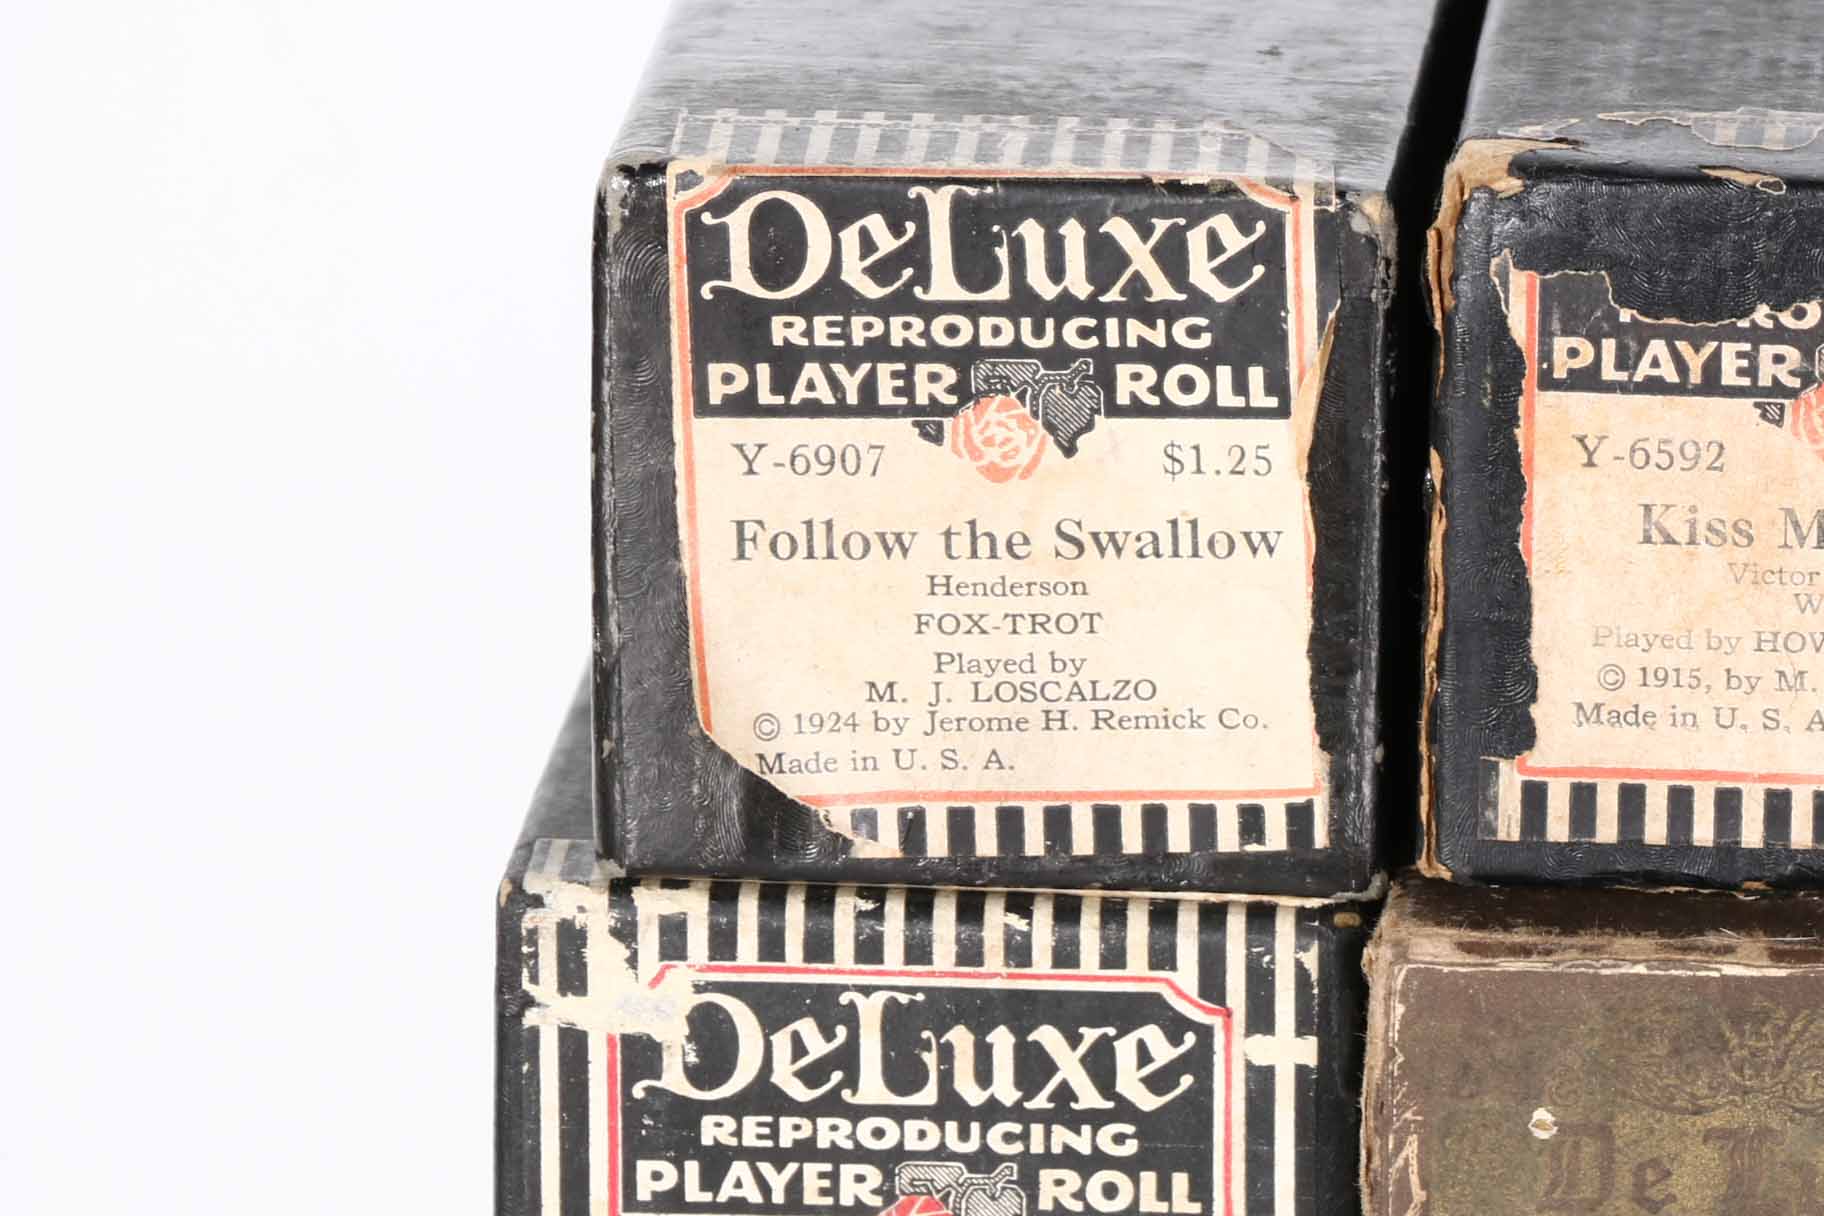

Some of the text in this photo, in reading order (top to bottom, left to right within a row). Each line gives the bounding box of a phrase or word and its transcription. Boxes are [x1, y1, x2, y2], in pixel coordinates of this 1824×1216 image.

[700, 184, 1265, 303] DeLuxe
[771, 315, 1212, 349] REPRODUCING
[1553, 336, 1801, 388] PLAYER
[708, 363, 1278, 407] PLAYER ROLL
[731, 440, 1272, 481] Y-6907 $1.25
[1571, 434, 1725, 472] Y-6592
[731, 518, 1283, 561] Follow the Swallow
[1638, 504, 1754, 548] Kiss
[926, 575, 1089, 597] Henderson
[1727, 564, 1821, 587] Victor
[914, 612, 1103, 636] FOX-TROT
[1592, 625, 1694, 654] Played
[1704, 628, 1743, 656] by
[933, 650, 1087, 678] Played by
[1639, 666, 1711, 694] 1915,
[1724, 667, 1763, 696] by
[971, 679, 1157, 703] LOSCALZO
[794, 707, 1268, 736] 1924 by Jerome Remick Co.
[1573, 702, 1699, 730] Made in
[755, 750, 880, 775] Made in
[633, 989, 1196, 1112] DeLuxe
[701, 1115, 1138, 1156] REPRODUCING
[636, 1160, 1201, 1214] PLAYER ROLL
